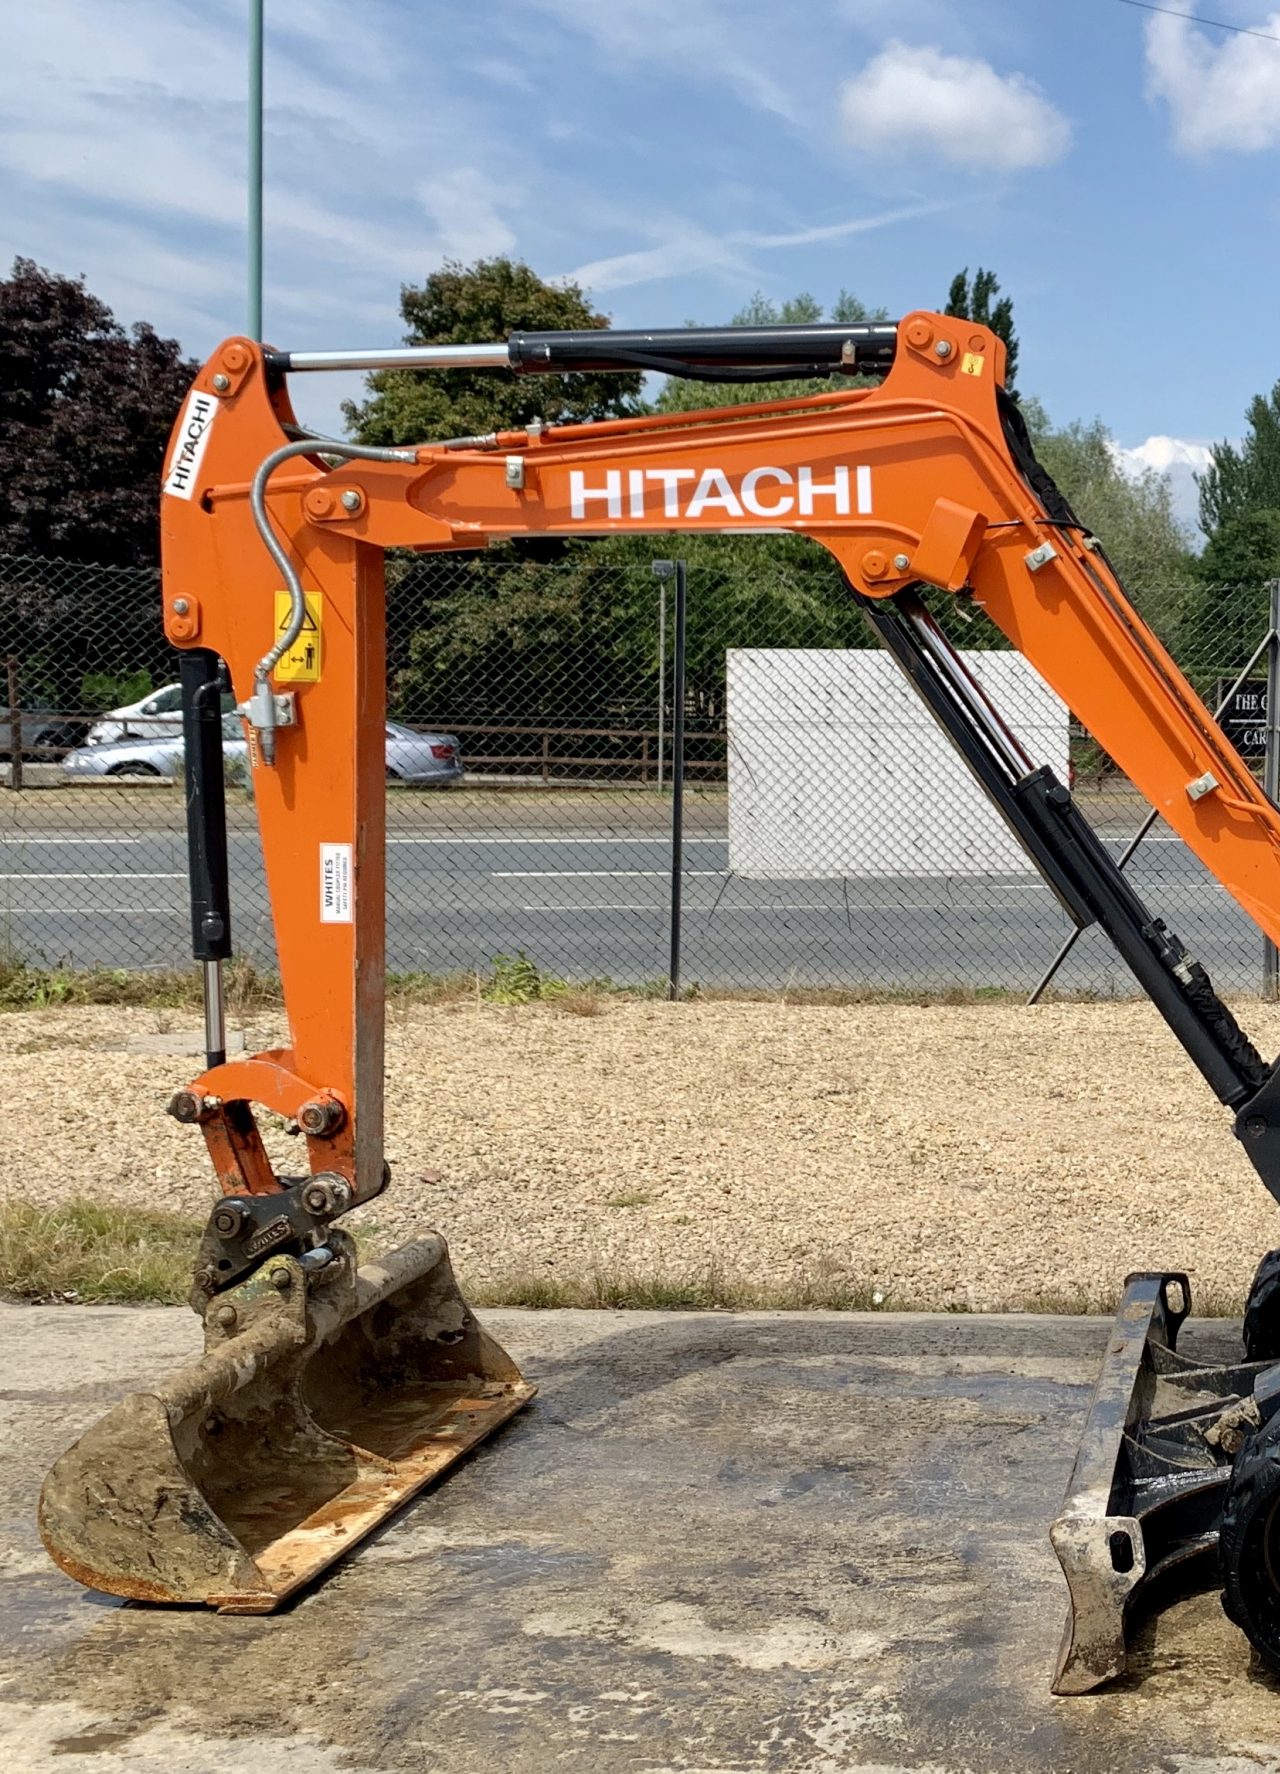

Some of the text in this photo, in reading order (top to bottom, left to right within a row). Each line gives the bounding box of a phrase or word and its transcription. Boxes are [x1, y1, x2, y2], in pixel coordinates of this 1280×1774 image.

[172, 399, 210, 490] HITACHI
[569, 466, 872, 518] HITACHI
[1235, 694, 1259, 710] THE
[325, 859, 333, 907] WHITES
